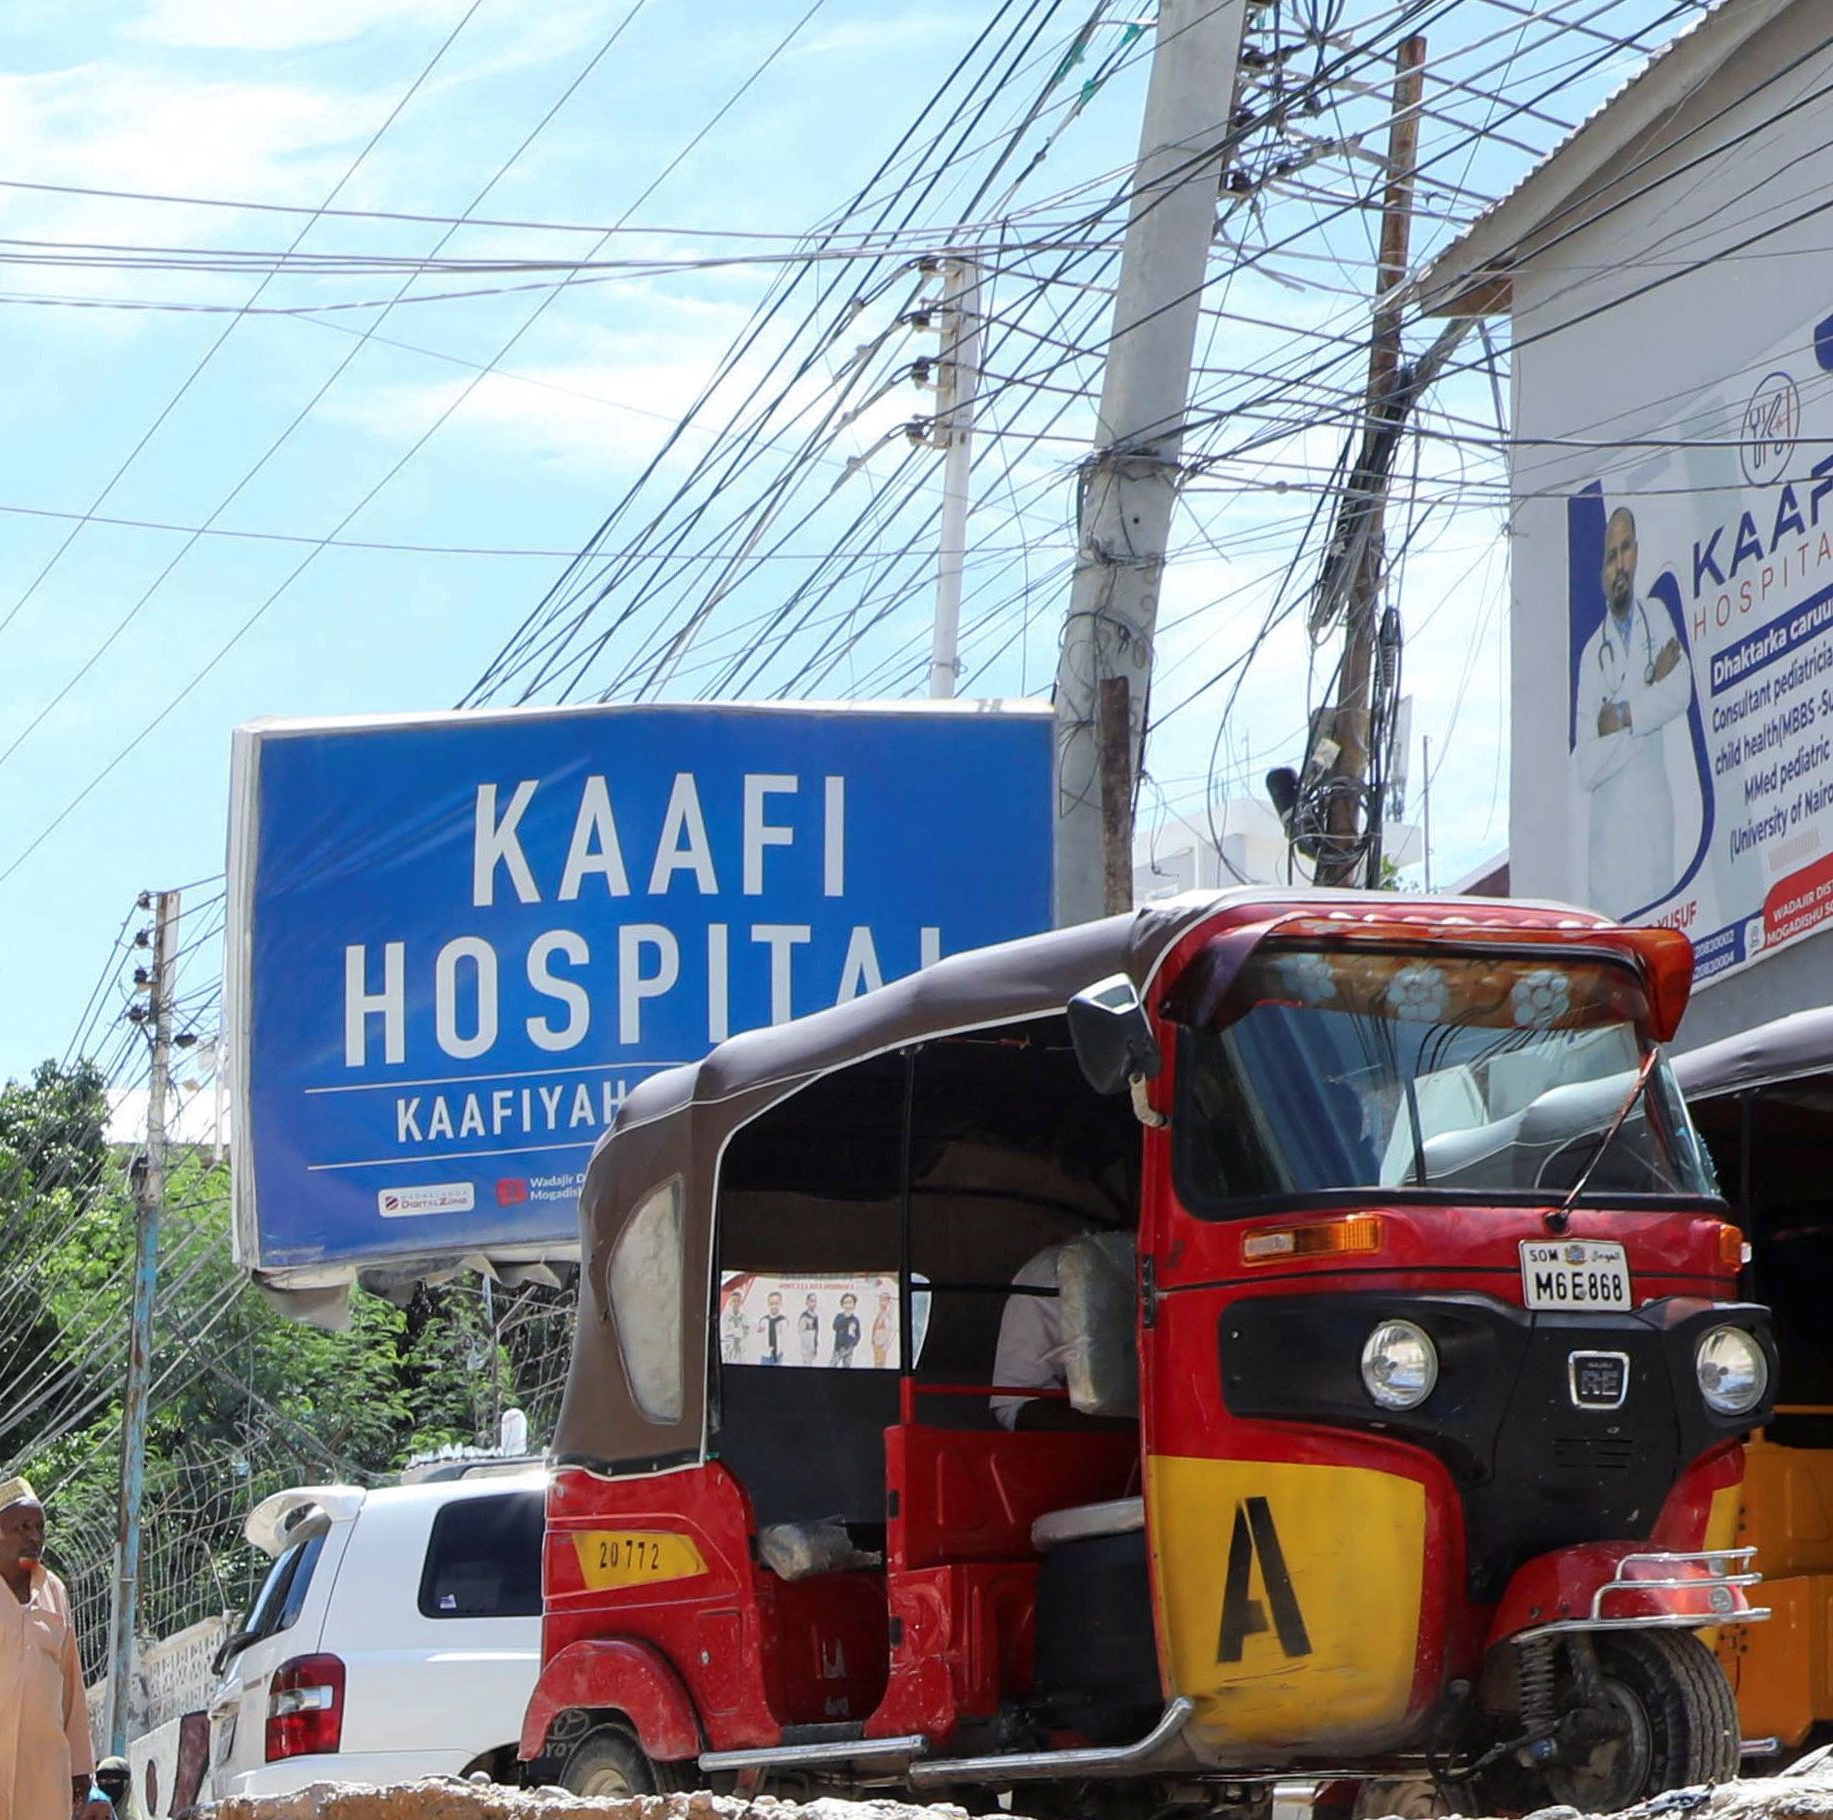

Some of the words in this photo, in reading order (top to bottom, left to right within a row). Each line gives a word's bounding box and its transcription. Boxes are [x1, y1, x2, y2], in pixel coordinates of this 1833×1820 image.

[1714, 628, 1788, 687] Dhaktarka
[1713, 680, 1771, 733] Consultant
[1715, 736, 1741, 776] child
[1744, 761, 1778, 806] MMed
[1779, 733, 1831, 793] pediatric
[473, 773, 845, 907] KAAFI
[1730, 805, 1789, 864] (University
[1790, 793, 1803, 824] of
[1767, 905, 1824, 946] MOGADISHU
[396, 1080, 626, 1143] KAAFIYAH
[530, 1174, 574, 1188] Wadajir
[1530, 1249, 1559, 1263] SOM
[1215, 1495, 1313, 1663] A
